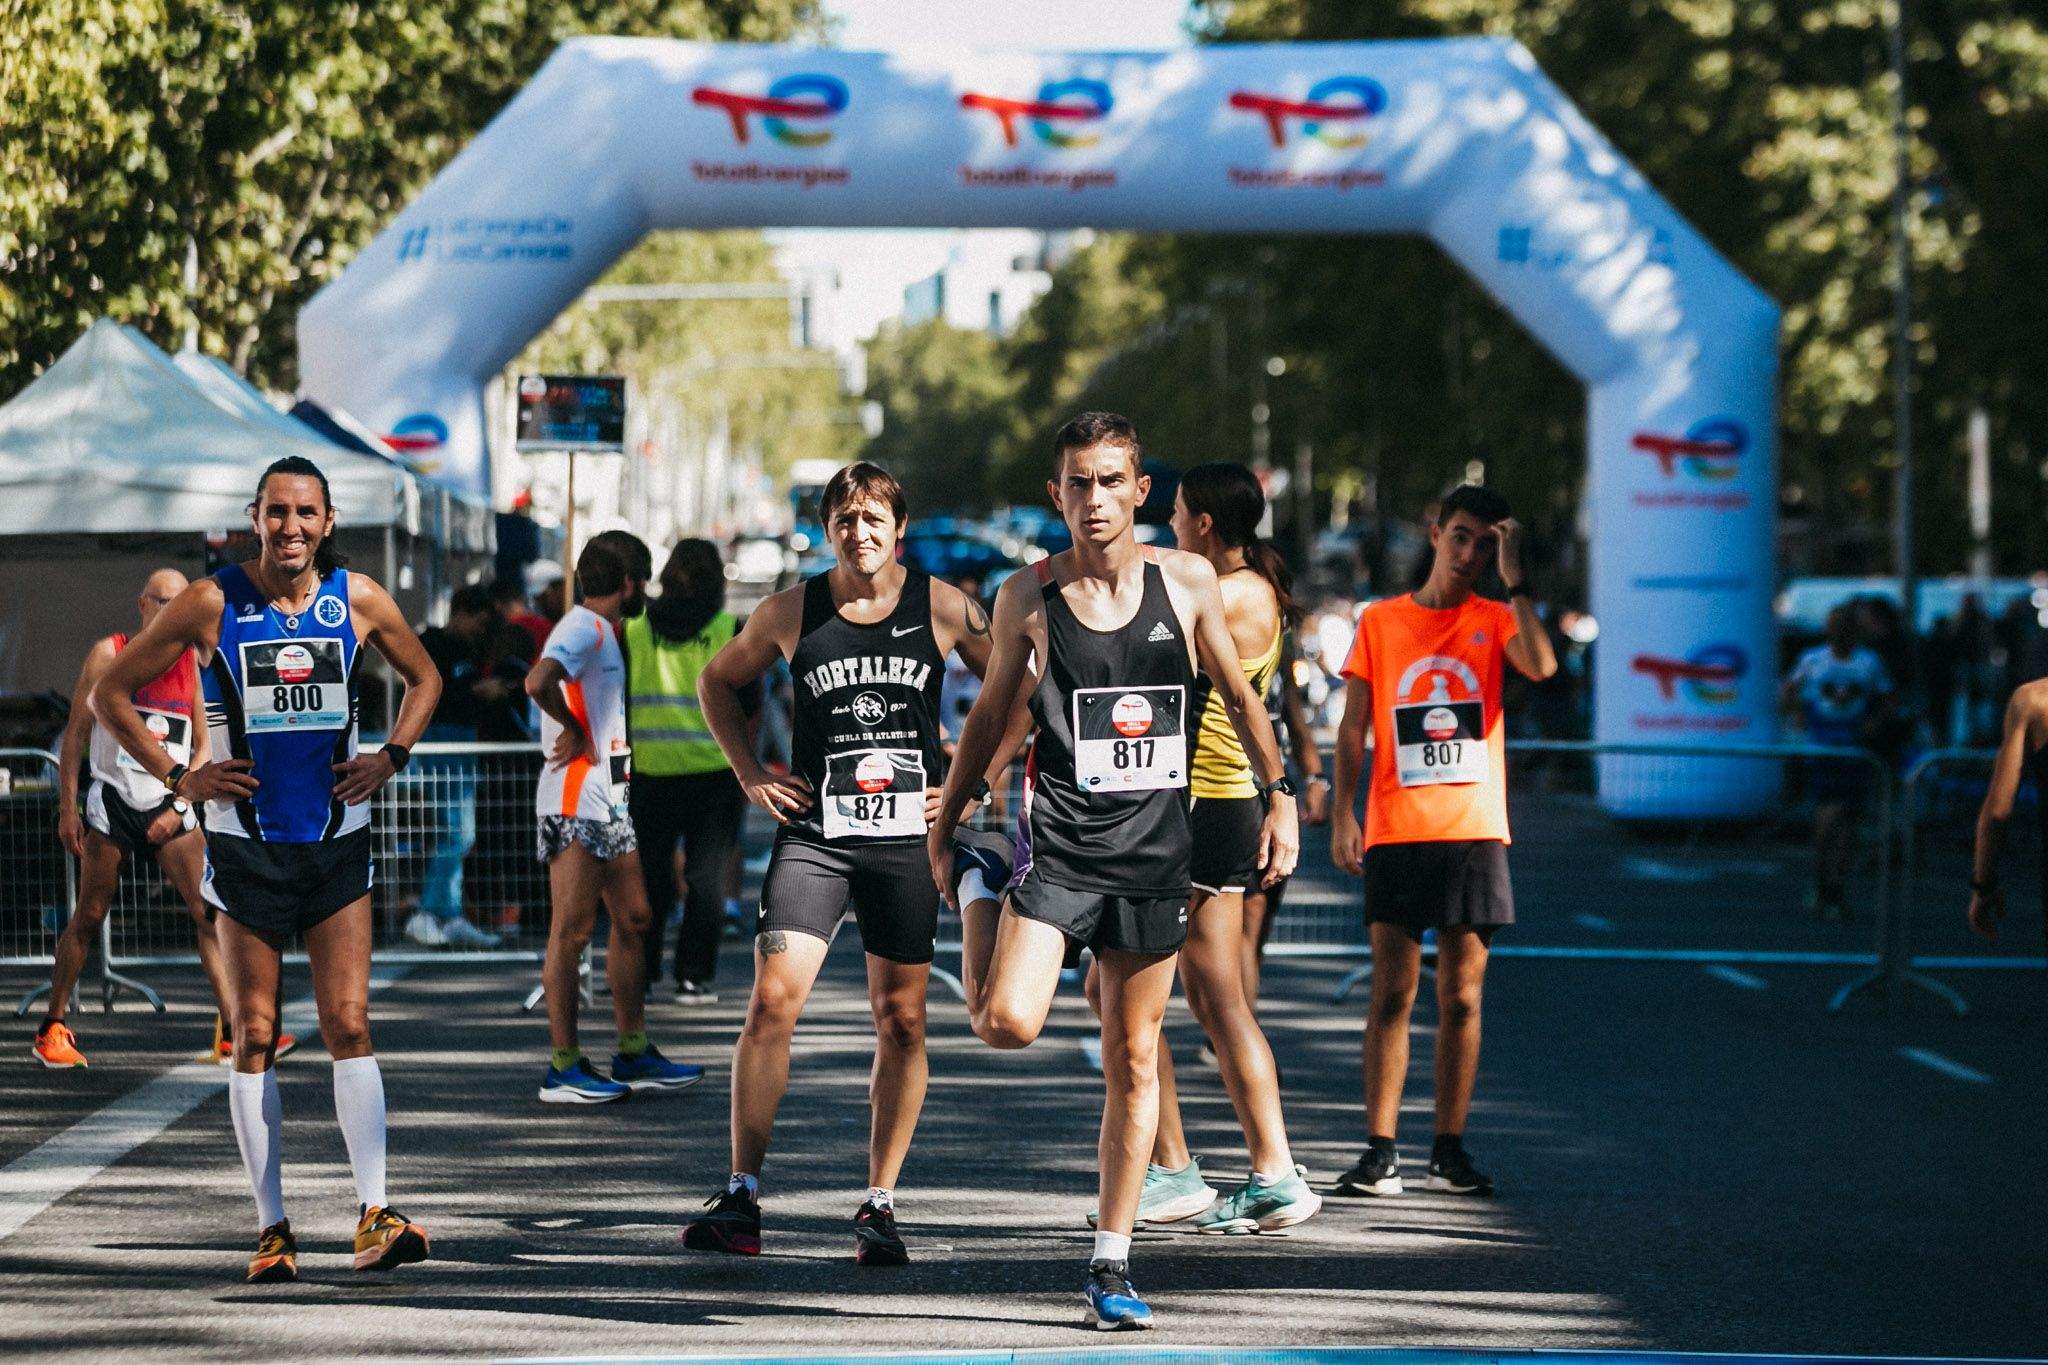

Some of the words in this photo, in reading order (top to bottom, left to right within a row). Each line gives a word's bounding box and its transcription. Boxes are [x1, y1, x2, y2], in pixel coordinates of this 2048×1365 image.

[803, 656, 931, 699] HORTALEZA
[273, 684, 323, 713] 800
[1113, 739, 1155, 770] 817
[1423, 742, 1462, 767] 807
[854, 794, 897, 821] 821
